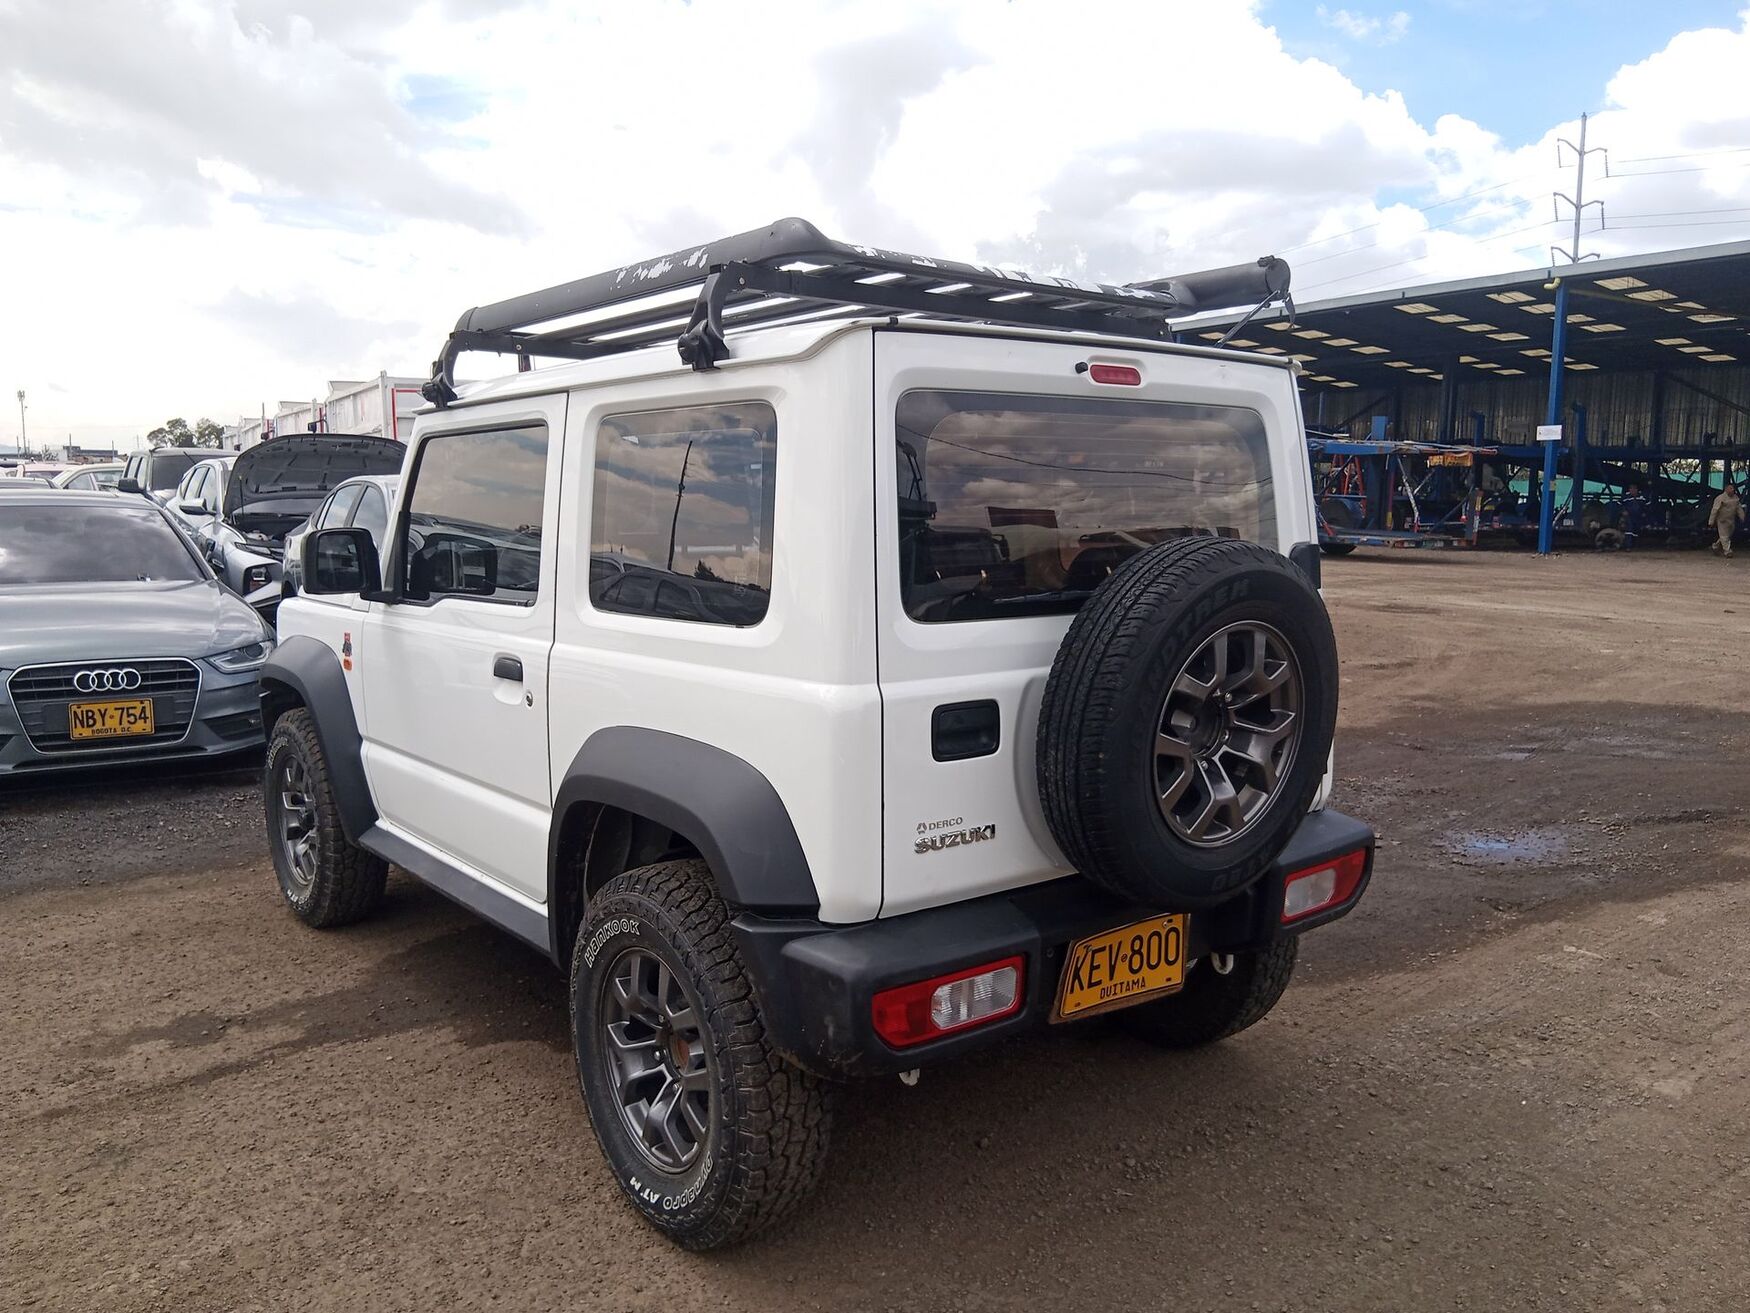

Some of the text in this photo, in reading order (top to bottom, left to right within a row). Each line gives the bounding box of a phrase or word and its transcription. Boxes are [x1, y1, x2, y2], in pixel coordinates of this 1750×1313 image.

[928, 817, 963, 831] DERCO
[914, 823, 996, 855] SUZUKI
[1100, 976, 1146, 999] DUITAMA
